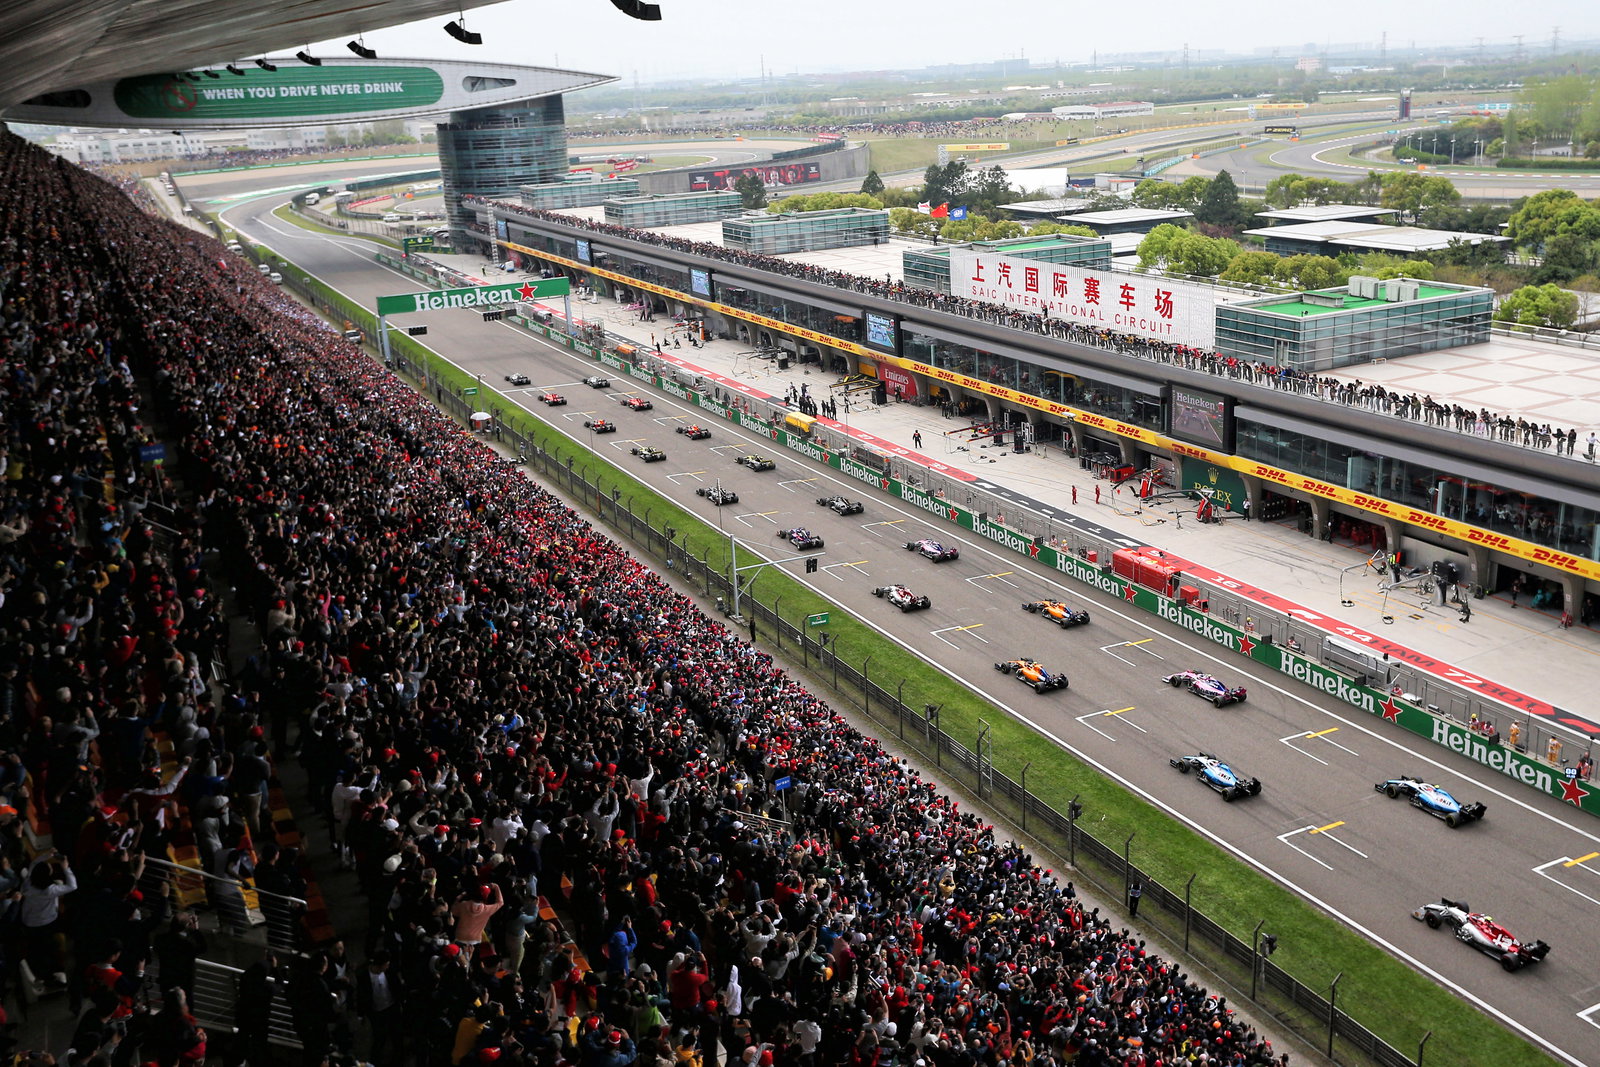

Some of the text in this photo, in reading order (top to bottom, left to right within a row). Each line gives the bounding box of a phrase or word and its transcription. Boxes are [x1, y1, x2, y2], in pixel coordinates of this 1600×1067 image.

[203, 82, 404, 100] WHEN YOU DRIVE NEVER DRINK
[972, 258, 1173, 320] 上汽国际赛车场
[413, 289, 515, 312] Heineken
[972, 285, 1173, 335] SAIC INTERNATIONAL CIRCUIT
[885, 369, 909, 385] Emirates
[913, 364, 930, 374] DHL
[937, 371, 955, 381] DHL
[662, 378, 687, 401] Heineken
[962, 379, 982, 390] DHL
[989, 387, 1010, 398] DHL
[699, 394, 727, 419] Heineken
[1018, 395, 1039, 407] DHL
[1175, 392, 1215, 410] Heineken
[739, 412, 771, 439] Heineken
[1081, 414, 1105, 427] DHL
[1116, 424, 1141, 438] DHL
[786, 432, 822, 462] Heineken
[839, 456, 880, 488] Heineken
[1256, 466, 1288, 482] DHL
[1303, 480, 1336, 497] DHL
[900, 483, 947, 519] Heineken
[1353, 495, 1390, 514] DHL
[1408, 512, 1448, 531] DHL
[972, 514, 1025, 555] Heineken
[1468, 529, 1511, 551] DHL
[1532, 548, 1579, 571] DHL
[1055, 552, 1120, 598] Heineken
[1210, 576, 1240, 588] 16
[1156, 597, 1234, 649] Heineken
[1336, 627, 1373, 642] 44
[1280, 650, 1375, 714] Heineken
[1444, 669, 1483, 683] 77
[1431, 717, 1553, 795] Heineken
